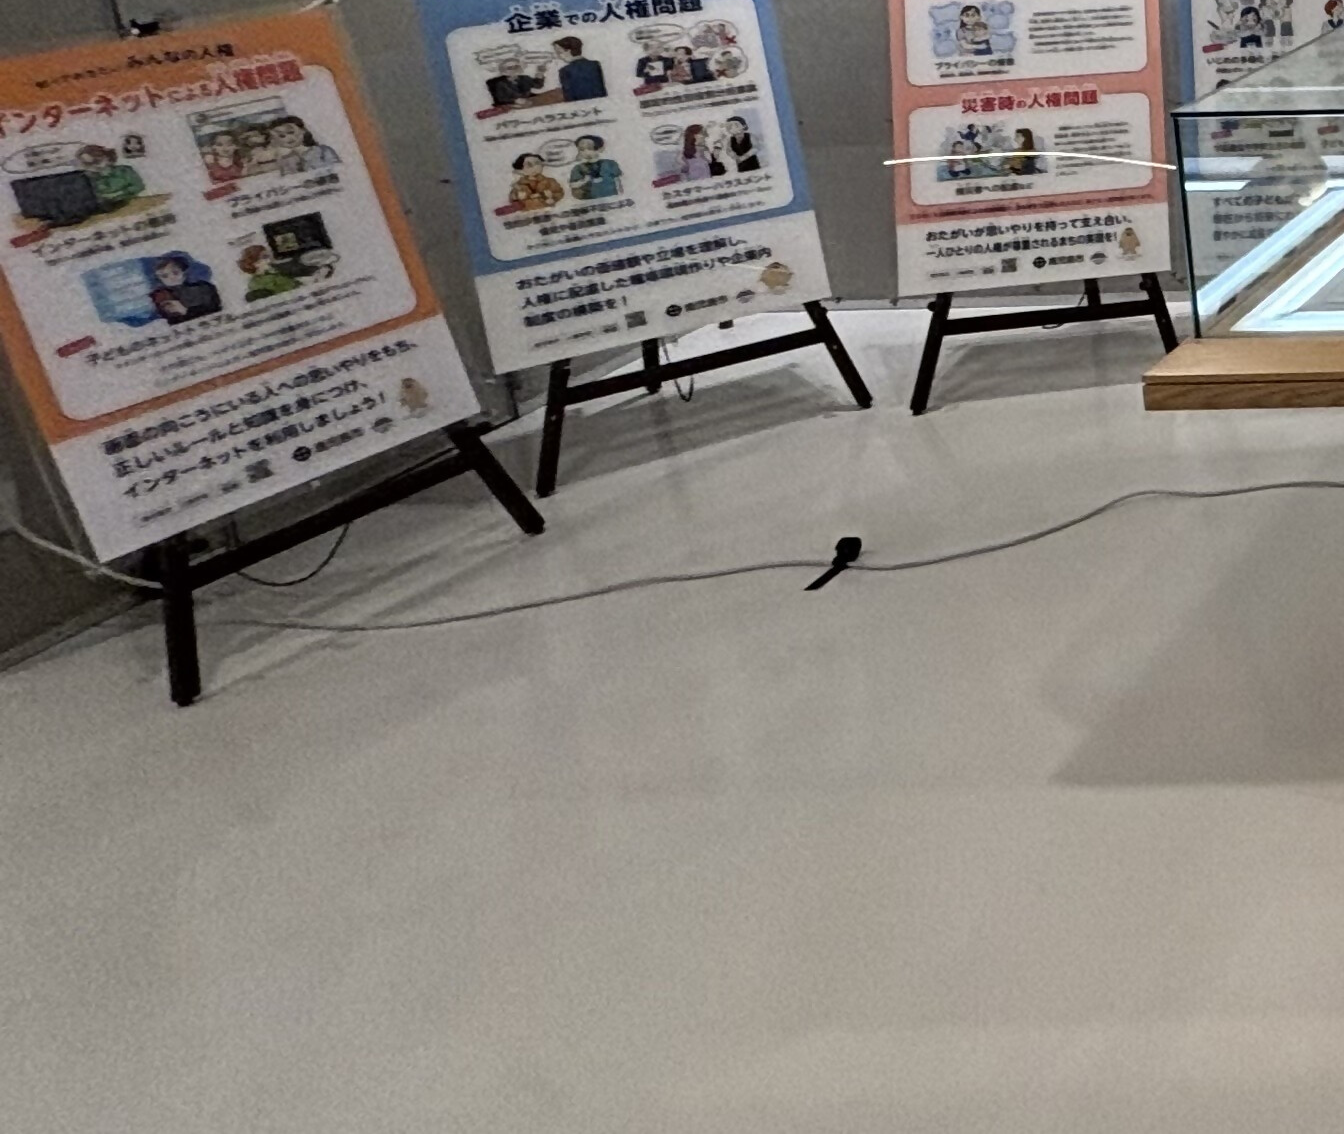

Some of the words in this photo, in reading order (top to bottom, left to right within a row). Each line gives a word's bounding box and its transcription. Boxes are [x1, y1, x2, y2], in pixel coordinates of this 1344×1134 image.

[126, 43, 235, 67] みんなの人権
[961, 89, 1099, 114] 災害時の人権問題
